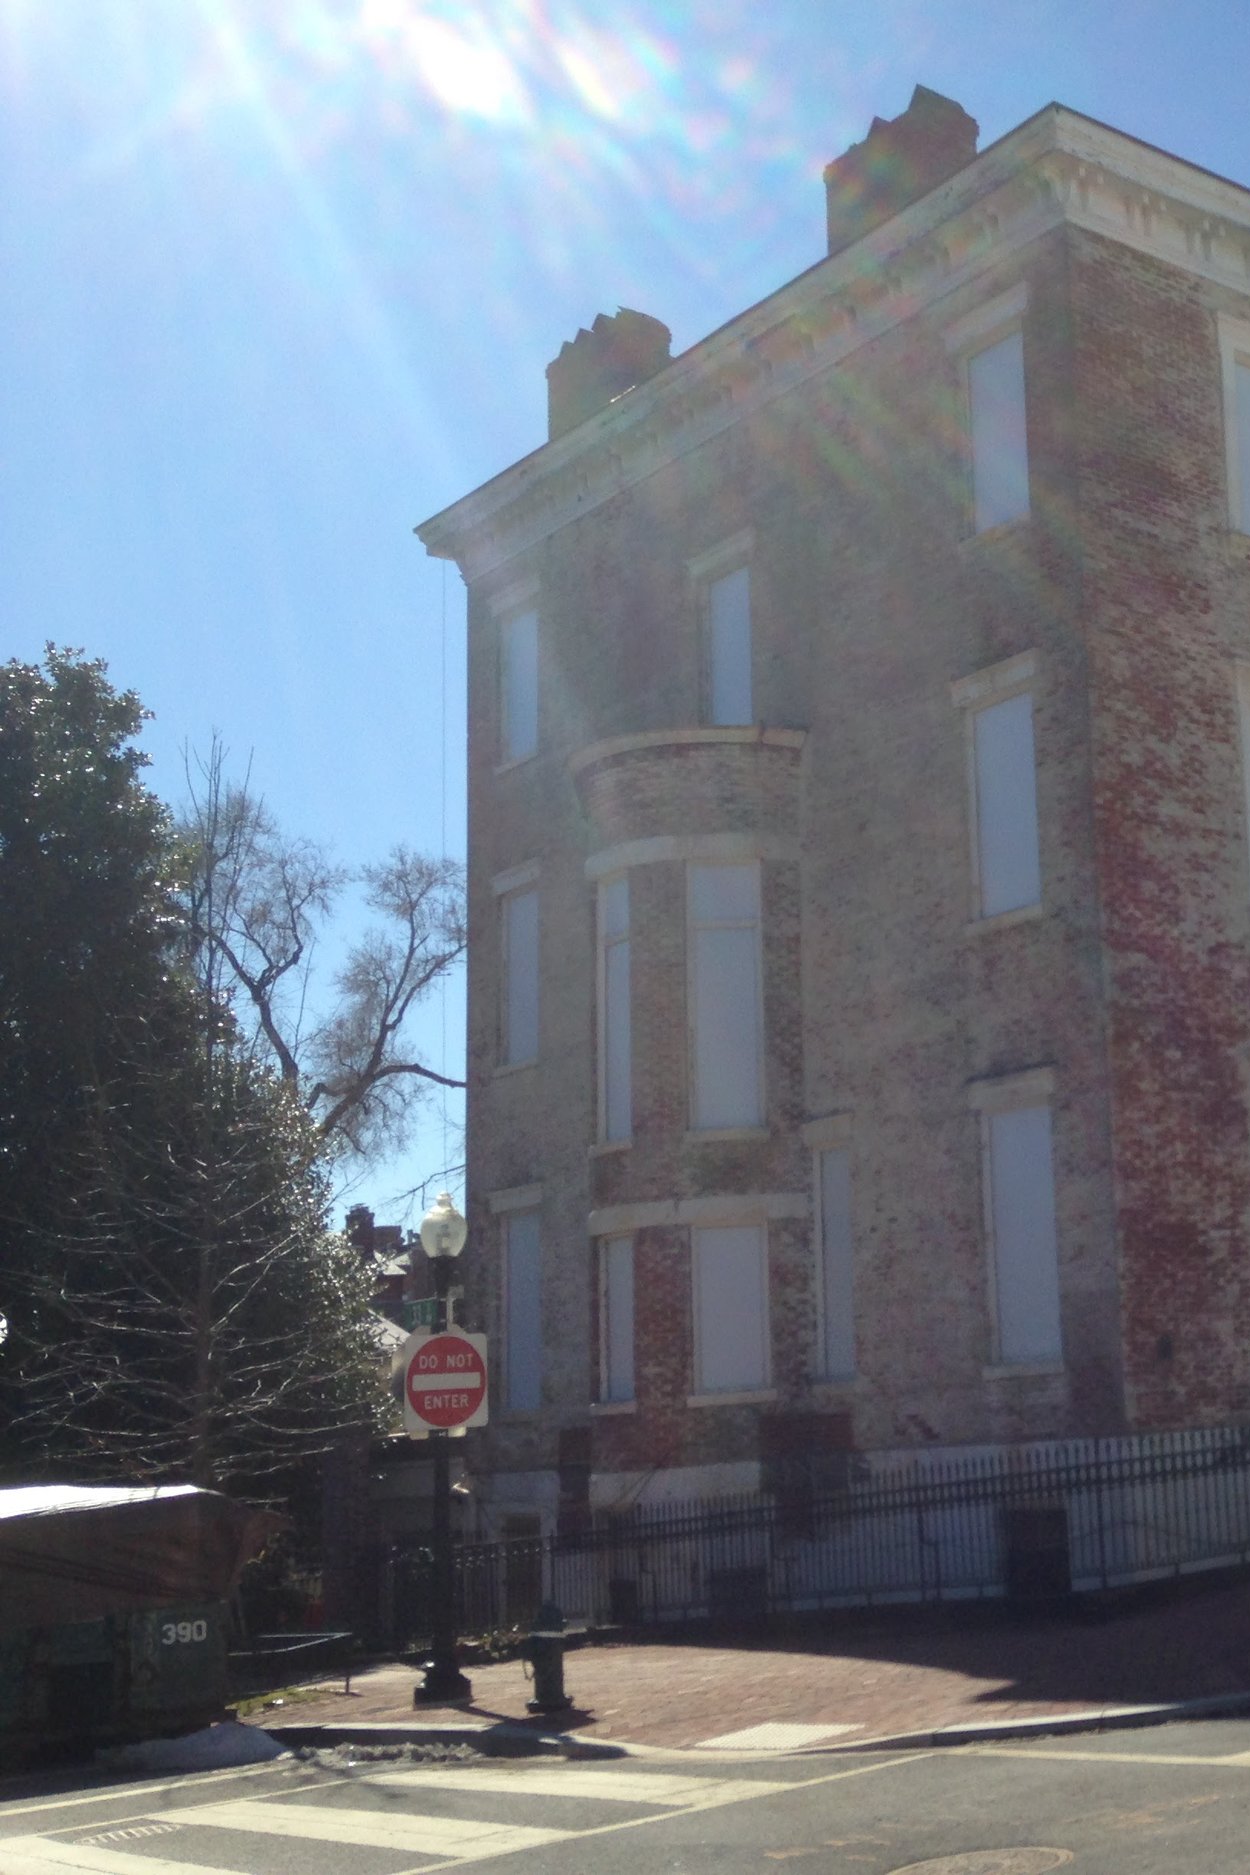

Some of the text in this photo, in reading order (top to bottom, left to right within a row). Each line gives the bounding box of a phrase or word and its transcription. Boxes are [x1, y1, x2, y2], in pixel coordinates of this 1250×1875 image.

[419, 1353, 474, 1369] DO NOT
[424, 1394, 469, 1410] ENTER
[161, 1620, 207, 1645] 390
